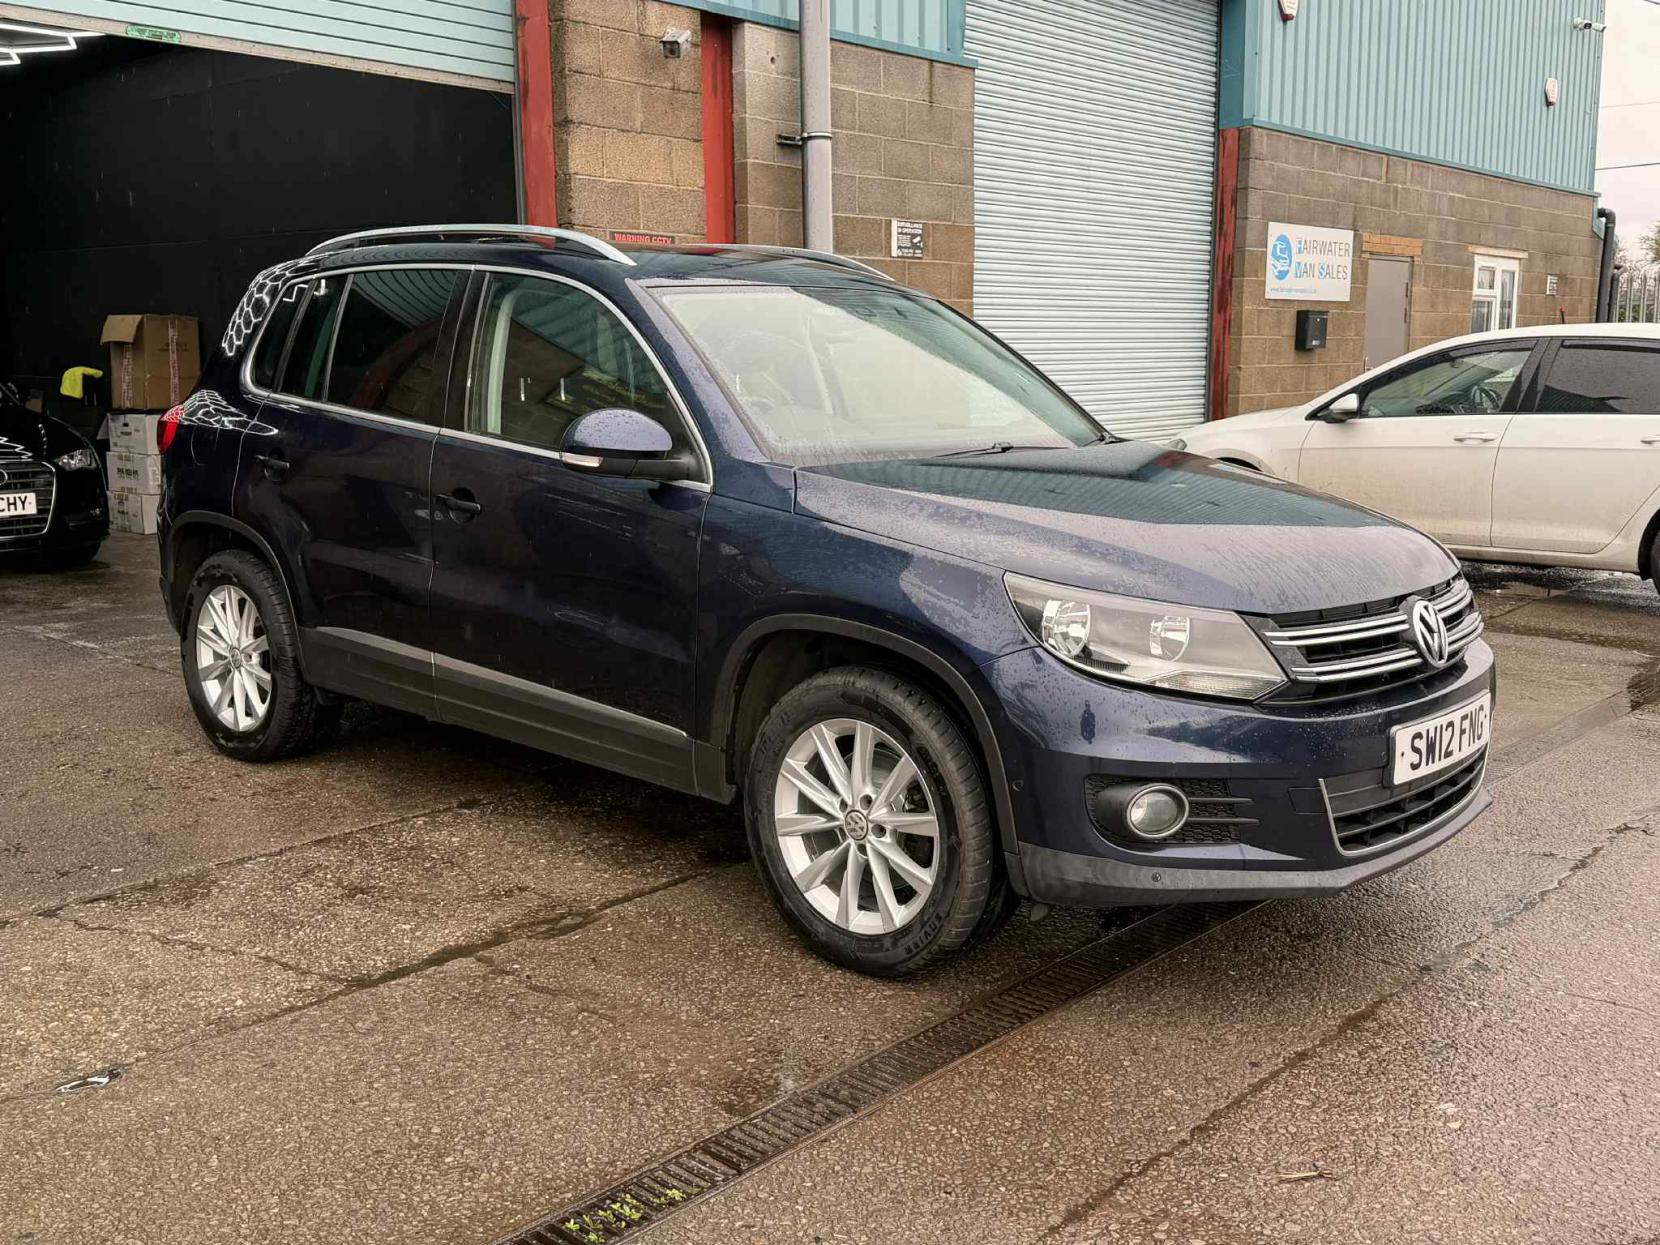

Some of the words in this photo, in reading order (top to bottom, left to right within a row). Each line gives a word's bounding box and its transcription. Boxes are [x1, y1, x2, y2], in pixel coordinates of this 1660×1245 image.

[614, 232, 650, 243] WARNING
[651, 236, 673, 245] CCTV
[1296, 238, 1351, 257] FAIRWATER
[1295, 262, 1315, 279] VAN
[1318, 264, 1348, 280] SALES
